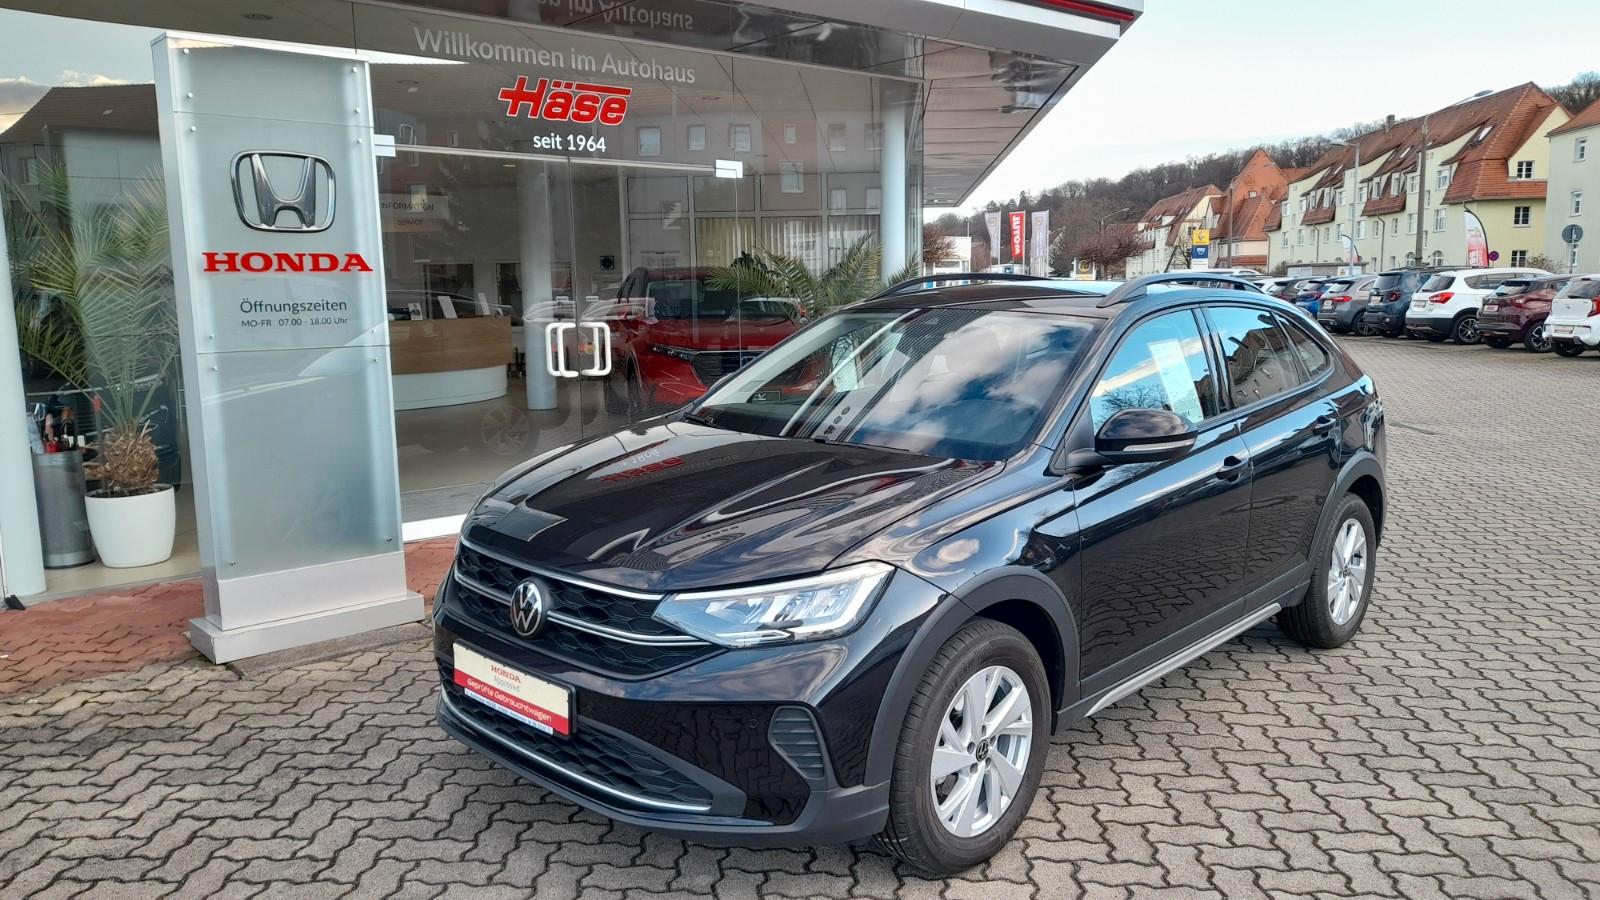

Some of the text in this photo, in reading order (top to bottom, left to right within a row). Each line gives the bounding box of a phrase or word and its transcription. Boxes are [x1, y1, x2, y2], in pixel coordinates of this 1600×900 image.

[413, 26, 696, 84] Willkommen im Autohaus
[498, 75, 631, 126] Häse
[533, 133, 606, 152] seit 1964
[202, 252, 373, 272] HONDA
[240, 298, 347, 315] Öffnungszeiten
[241, 319, 272, 328] MO-FR
[278, 318, 302, 327] 07.00
[310, 317, 332, 326] 18.00
[333, 316, 348, 325] Uhr
[490, 664, 521, 684] HONDA
